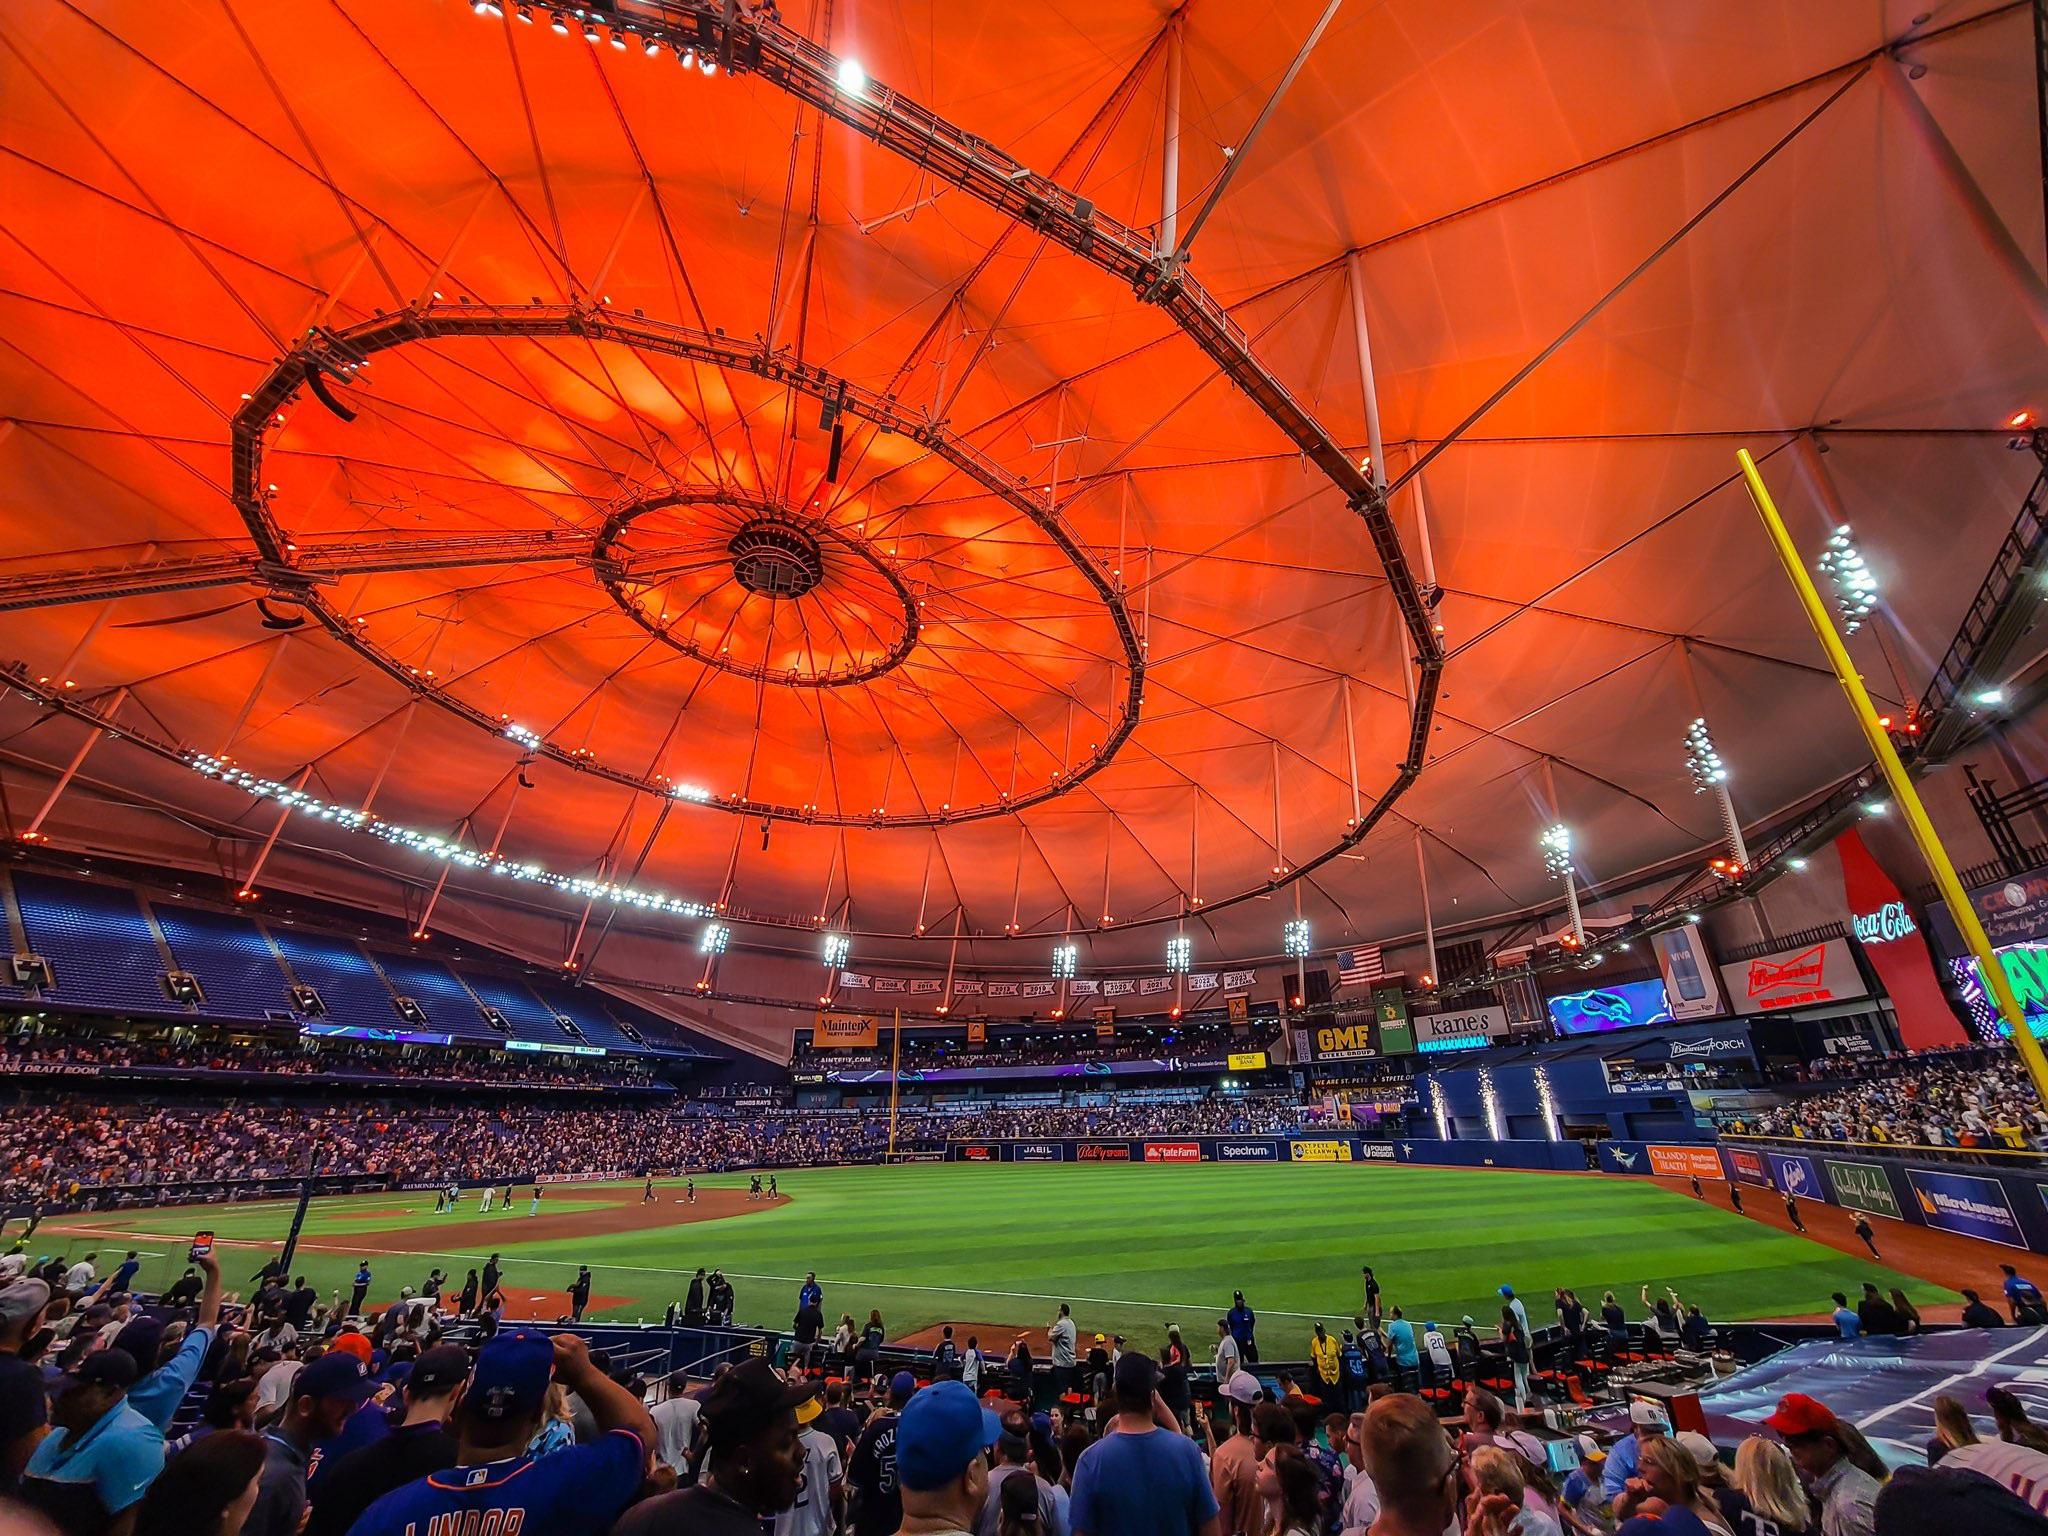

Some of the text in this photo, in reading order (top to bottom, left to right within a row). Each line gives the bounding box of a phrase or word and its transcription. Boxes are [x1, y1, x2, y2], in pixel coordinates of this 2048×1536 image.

[1853, 900, 1917, 943] Coca-Cola
[1671, 950, 1691, 962] VIVA
[1979, 947, 2048, 1010] AY
[1146, 981, 1162, 989] 2021
[821, 1019, 872, 1035] MaintenX
[1317, 1025, 1369, 1051] GMF
[1710, 1040, 1745, 1050] PORCH
[24, 1065, 63, 1073] DRAFT
[1223, 1145, 1269, 1156] Spectrum
[1652, 1150, 1687, 1161] ORLANDO
[1430, 1338, 1444, 1350] 20
[873, 1428, 899, 1459] AROZ
